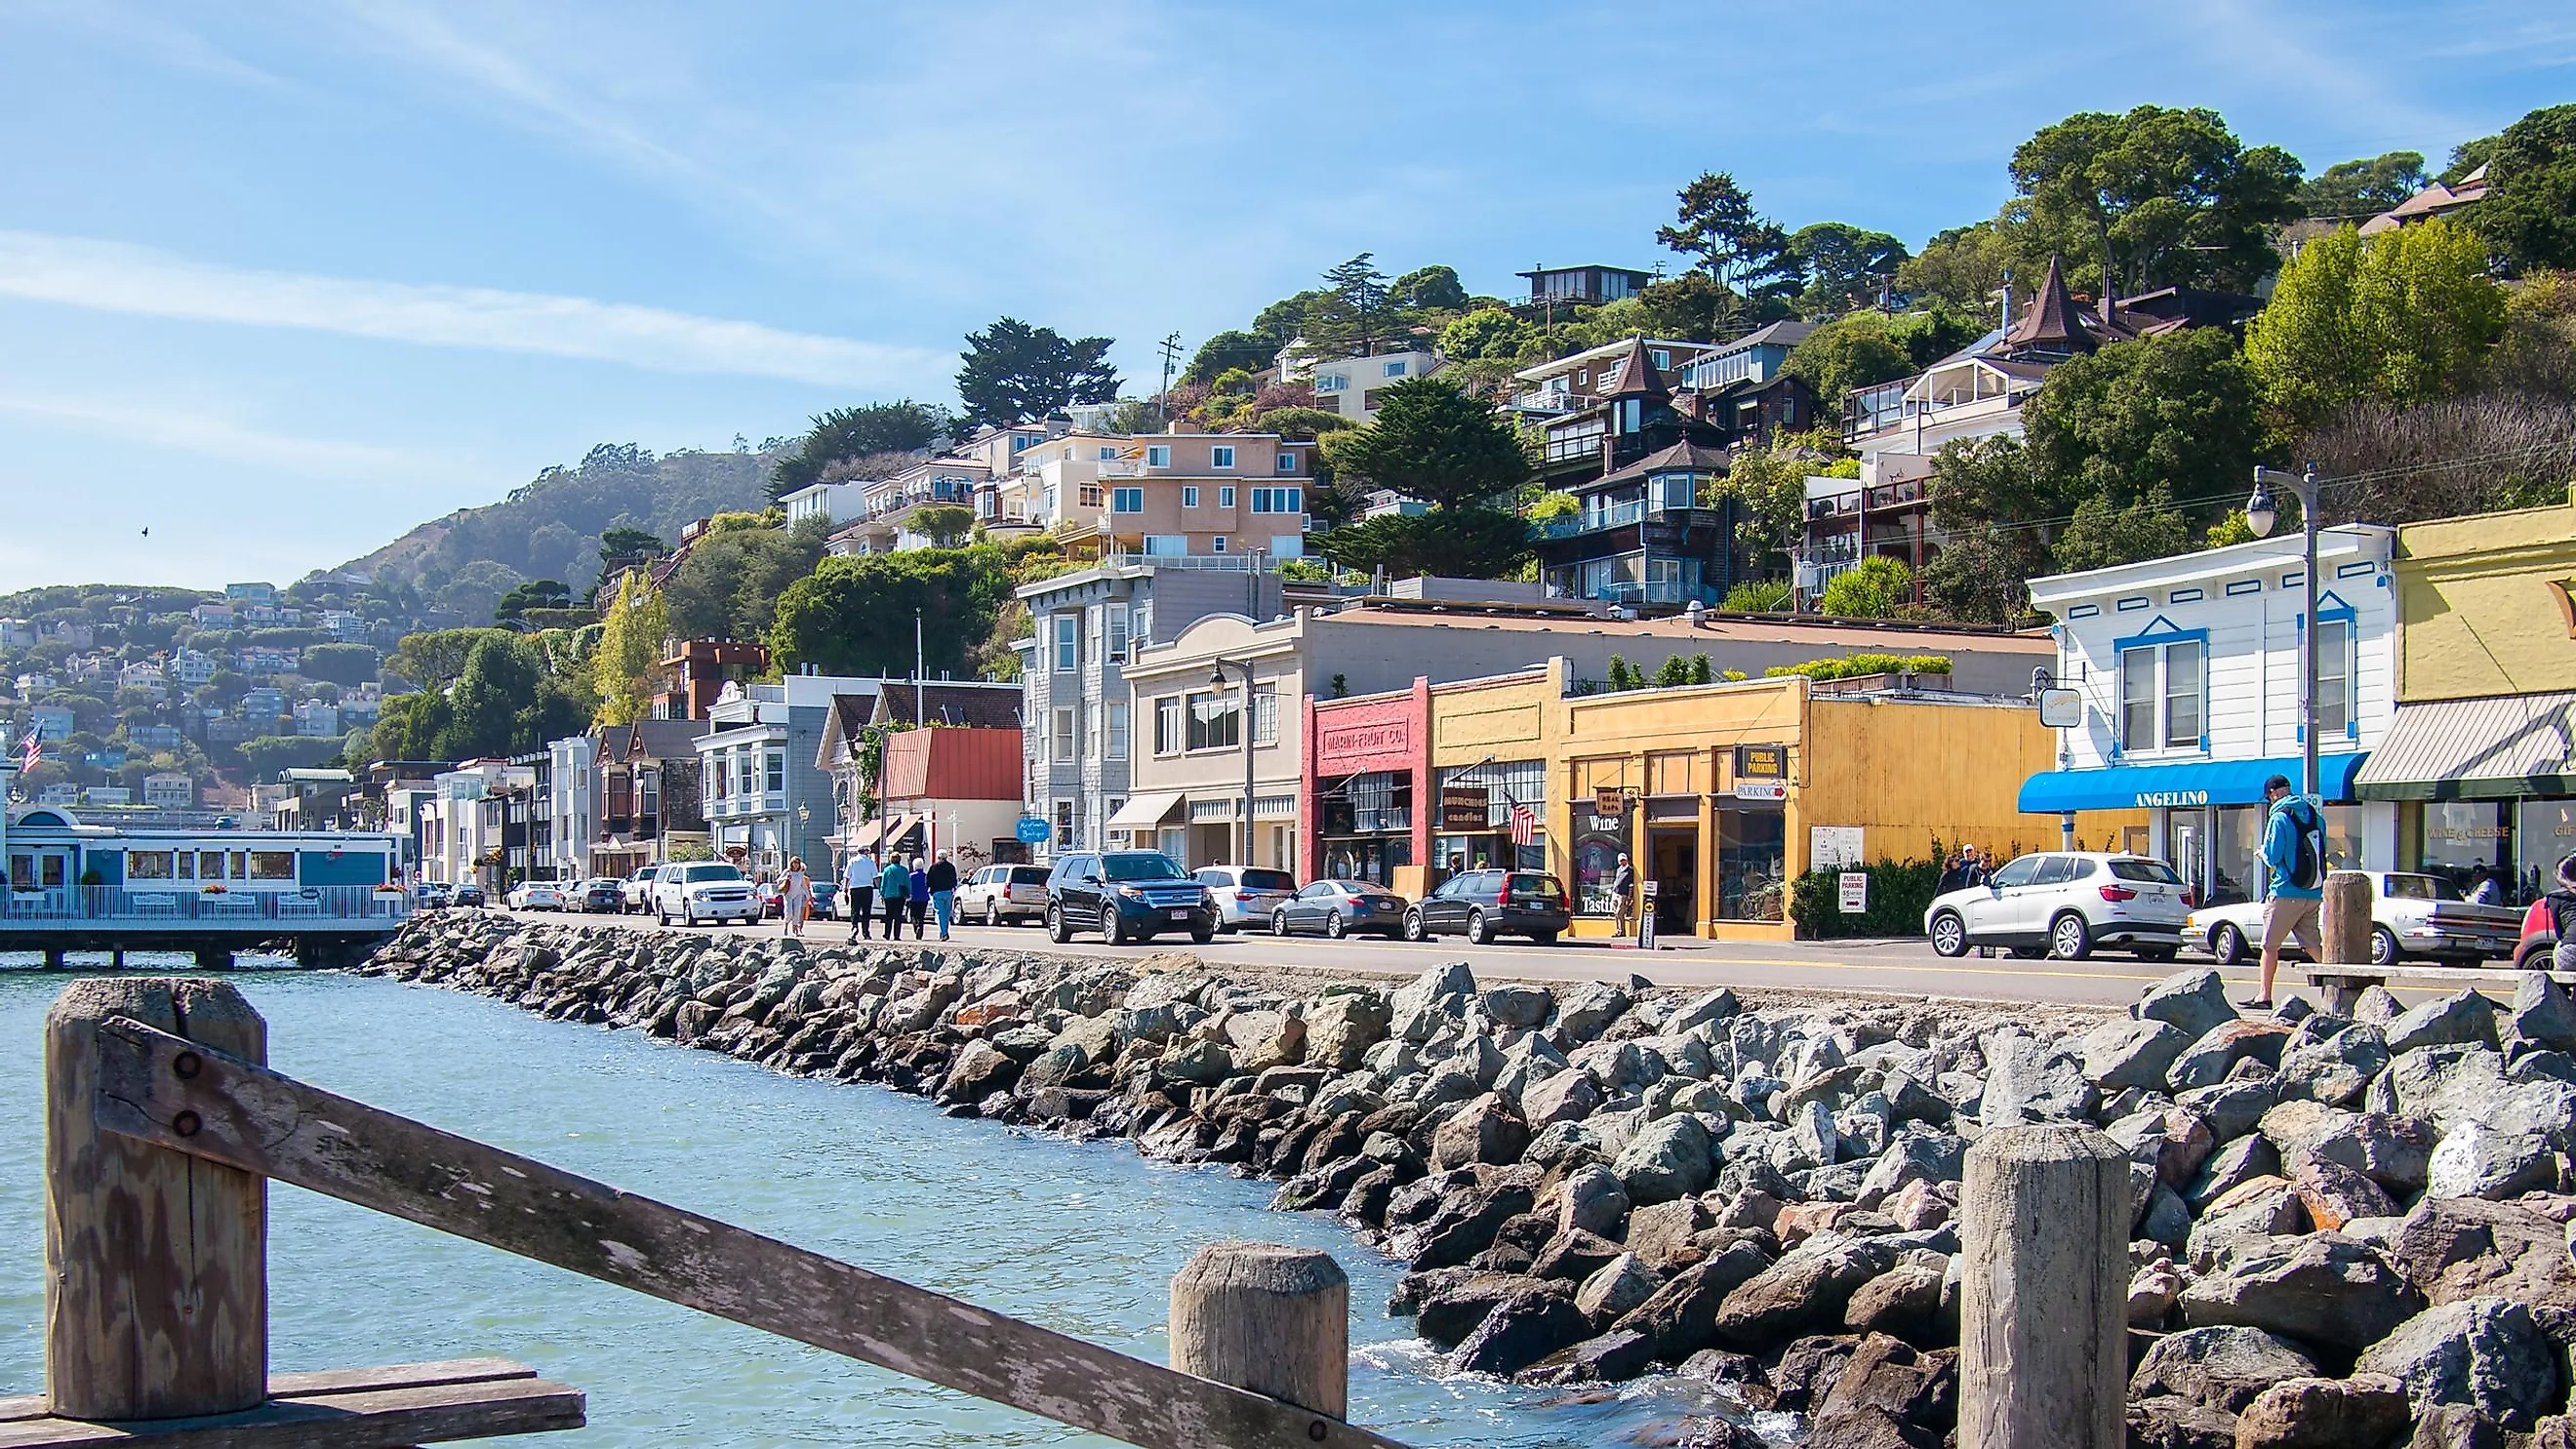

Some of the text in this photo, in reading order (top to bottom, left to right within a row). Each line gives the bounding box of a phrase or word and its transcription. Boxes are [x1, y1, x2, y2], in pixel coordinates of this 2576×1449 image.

[1389, 729, 1404, 744] CO.
[1751, 751, 1775, 763] PUBLIC
[1748, 762, 1778, 774] PARKING
[1737, 785, 1774, 797] PARKING
[2134, 789, 2208, 807] ANGELINO
[1590, 816, 1619, 832] Wine
[2429, 828, 2455, 839] WINE
[2466, 826, 2510, 838] CHEESE
